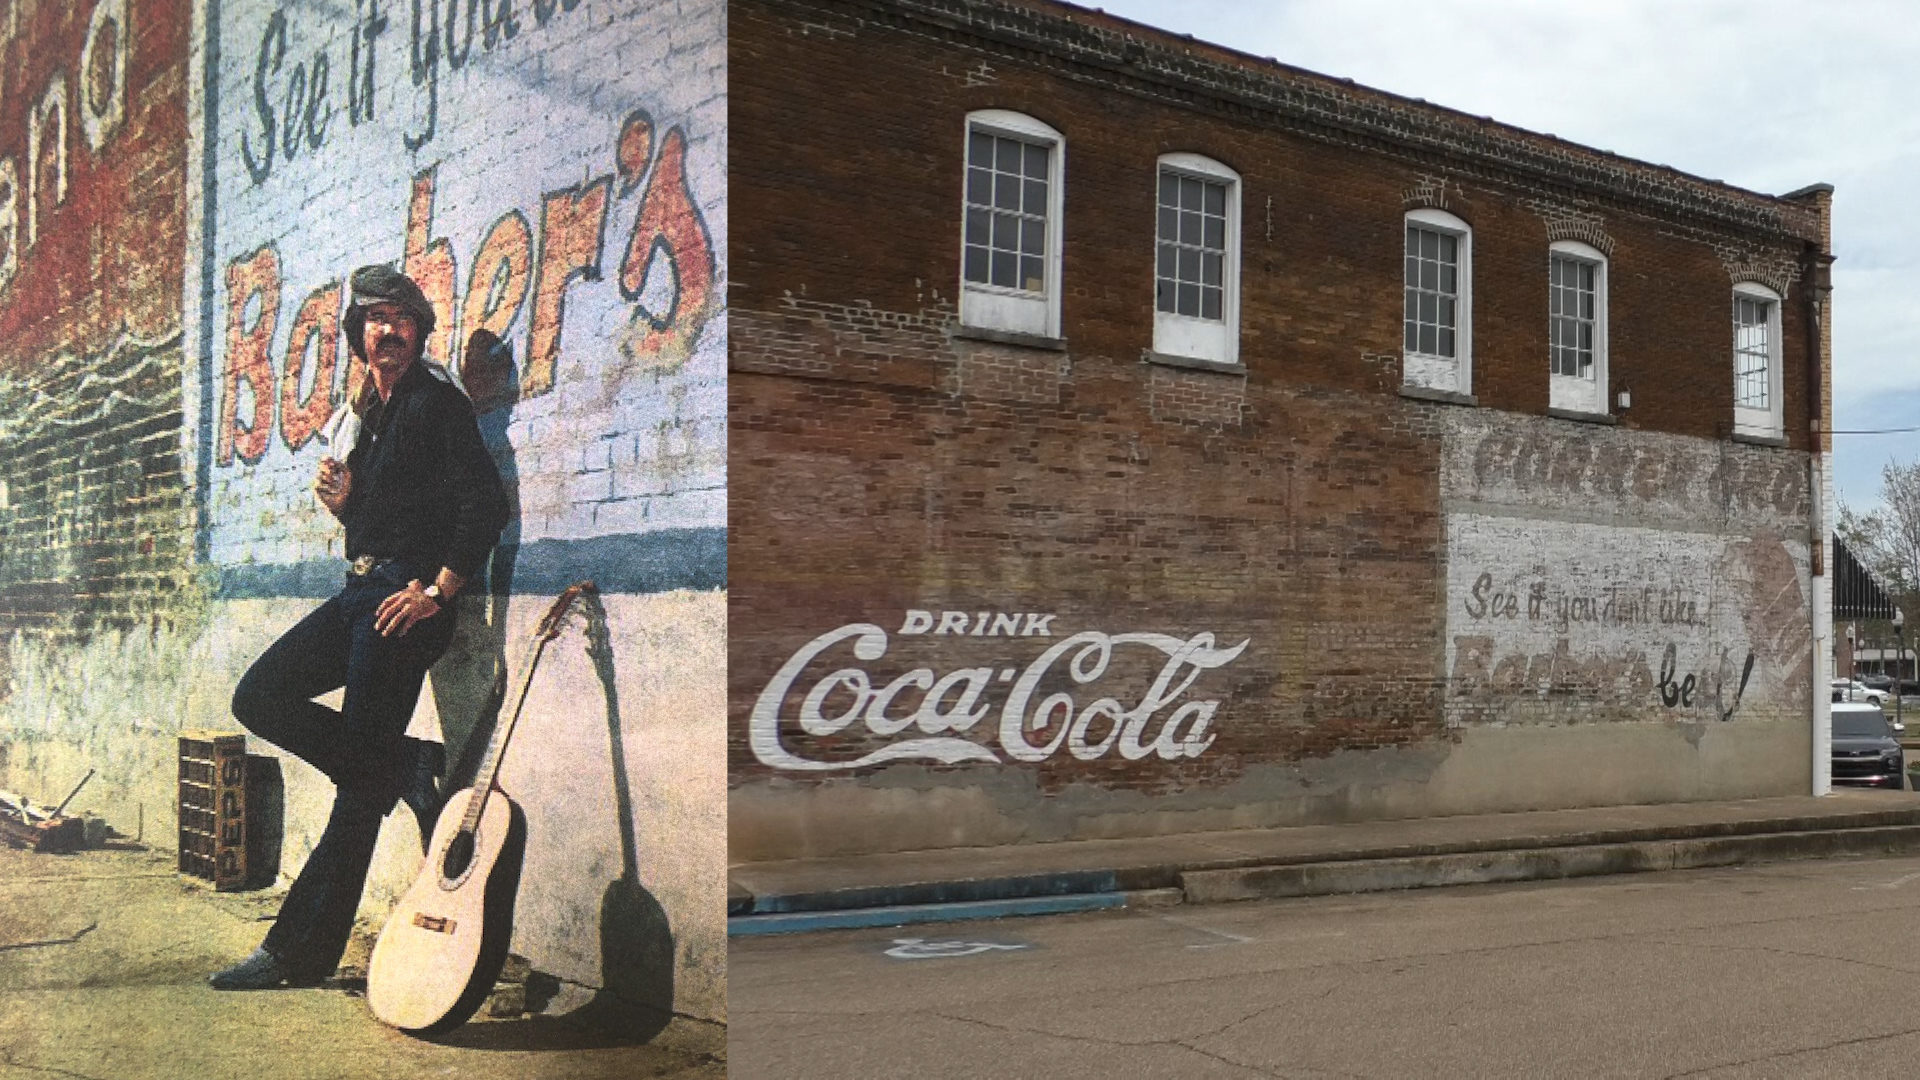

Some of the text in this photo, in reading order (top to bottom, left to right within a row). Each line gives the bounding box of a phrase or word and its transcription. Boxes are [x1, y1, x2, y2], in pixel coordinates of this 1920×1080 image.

[241, 9, 331, 187] See
[214, 108, 718, 468] Baber's
[898, 609, 1057, 637] DRINK
[1464, 571, 1519, 620] See
[749, 622, 1251, 771] Coca-Cola
